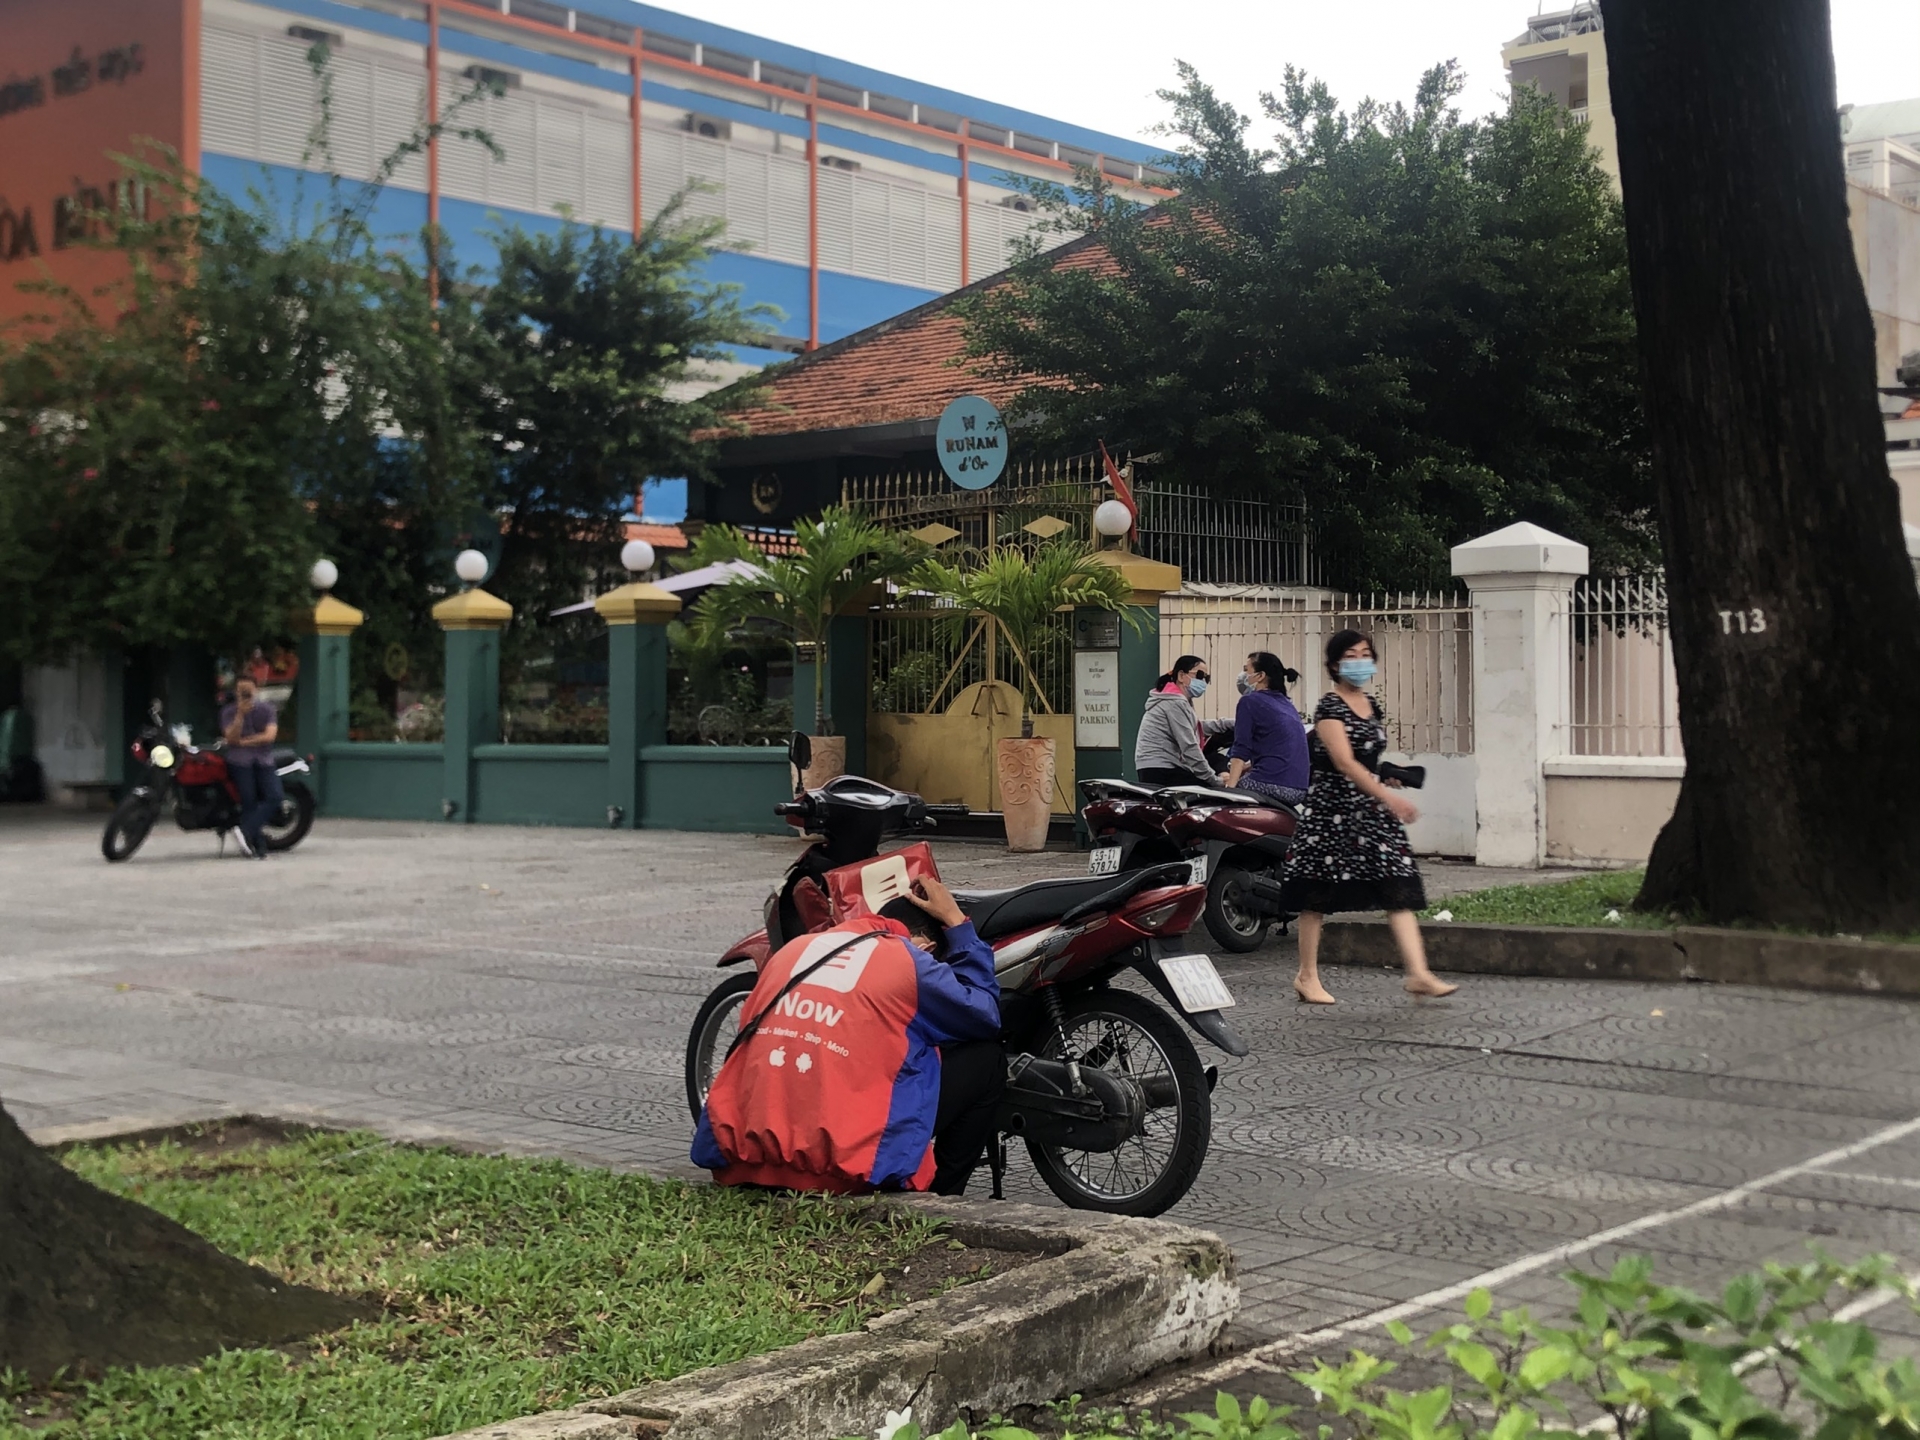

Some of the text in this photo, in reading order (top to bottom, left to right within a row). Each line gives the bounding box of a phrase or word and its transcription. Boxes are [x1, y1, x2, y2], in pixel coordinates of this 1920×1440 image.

[958, 455, 989, 472] d'Or
[1718, 608, 1767, 635] T13
[1084, 703, 1111, 713] VALET
[1079, 715, 1116, 725] PARKING
[804, 1032, 822, 1045] Ship
[828, 1040, 849, 1057] Moto
